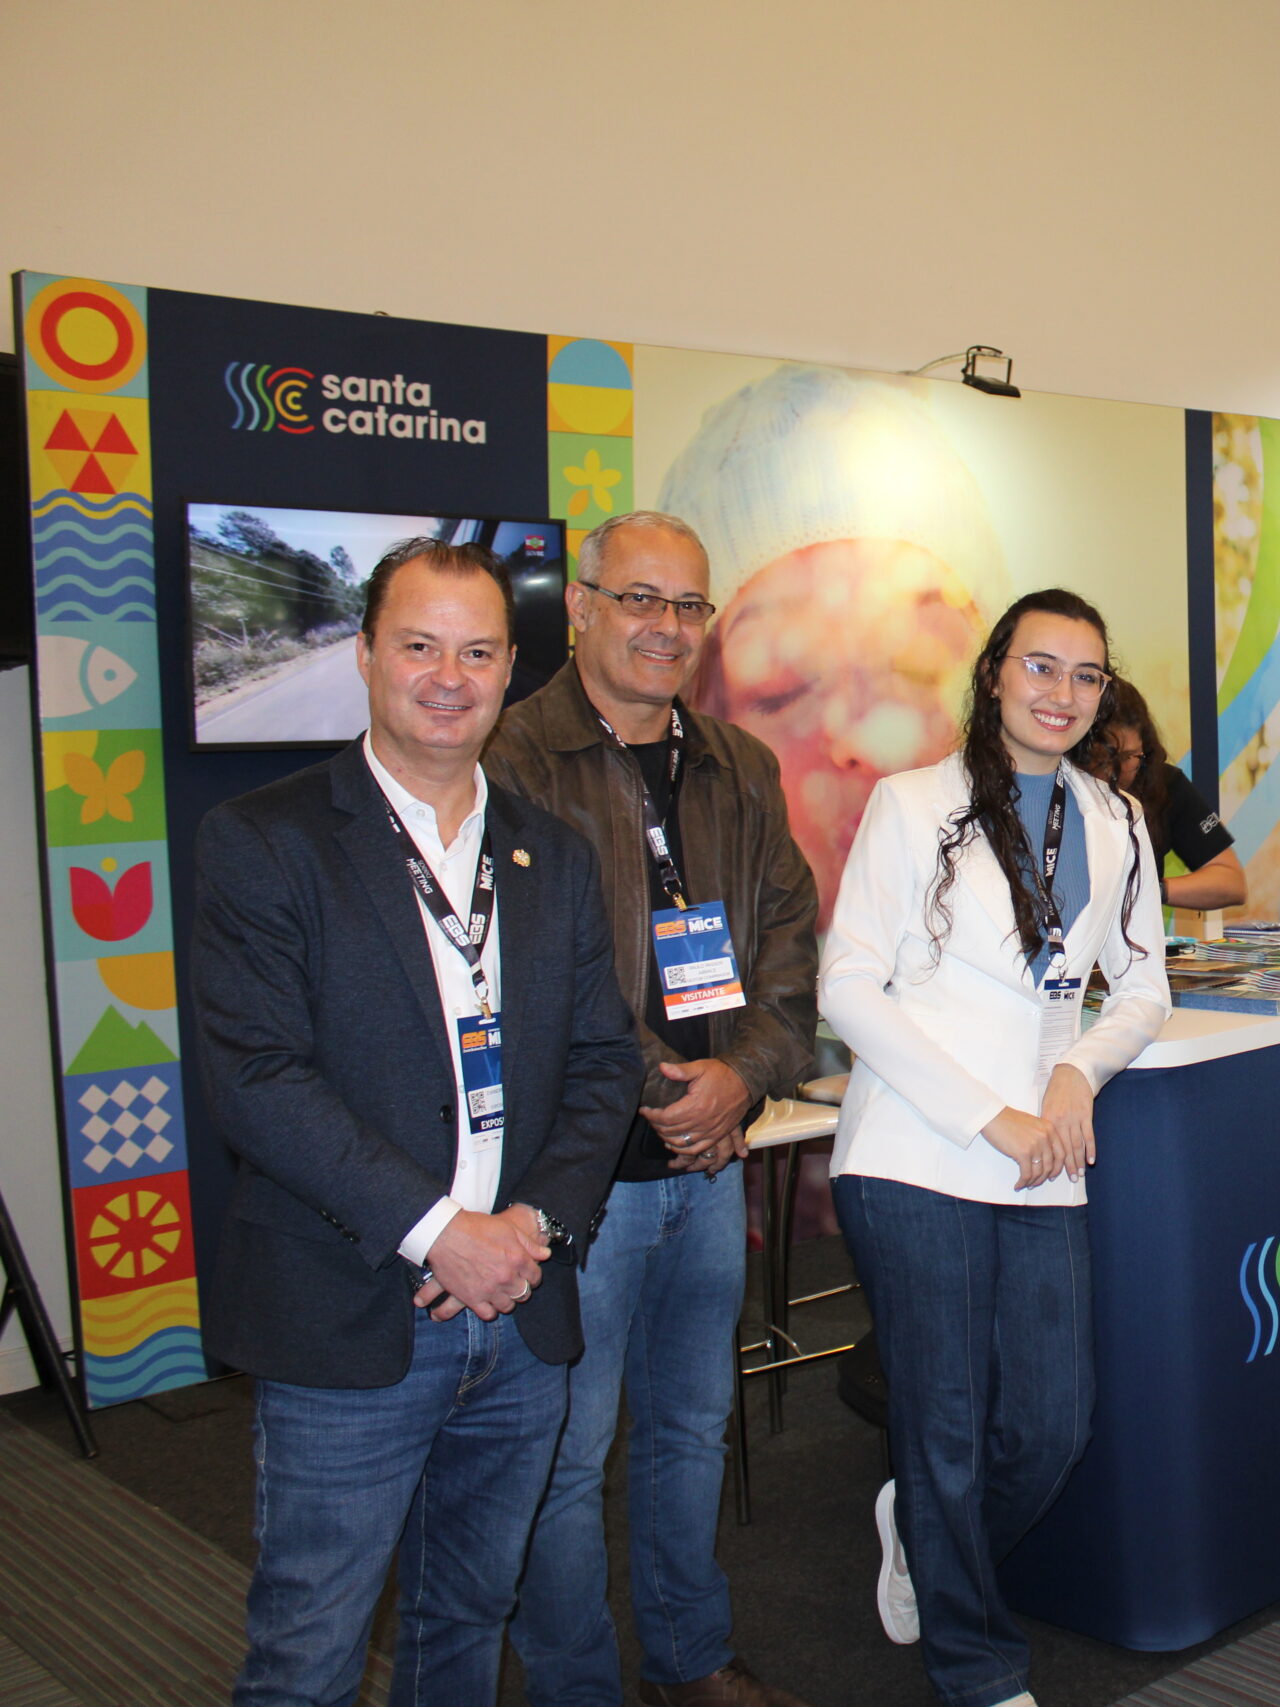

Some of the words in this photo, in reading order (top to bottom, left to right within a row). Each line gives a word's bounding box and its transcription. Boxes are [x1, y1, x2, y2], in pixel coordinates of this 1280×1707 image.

[321, 374, 431, 407] santa
[322, 405, 486, 444] catarina
[650, 827, 668, 855] EBS
[406, 858, 433, 894] MEETING
[479, 854, 494, 891] MICE
[1045, 848, 1057, 877] MICE
[442, 914, 471, 946] EBS
[469, 913, 486, 944] EBS
[688, 917, 722, 932] MICE
[681, 987, 726, 1002] VISITANTE
